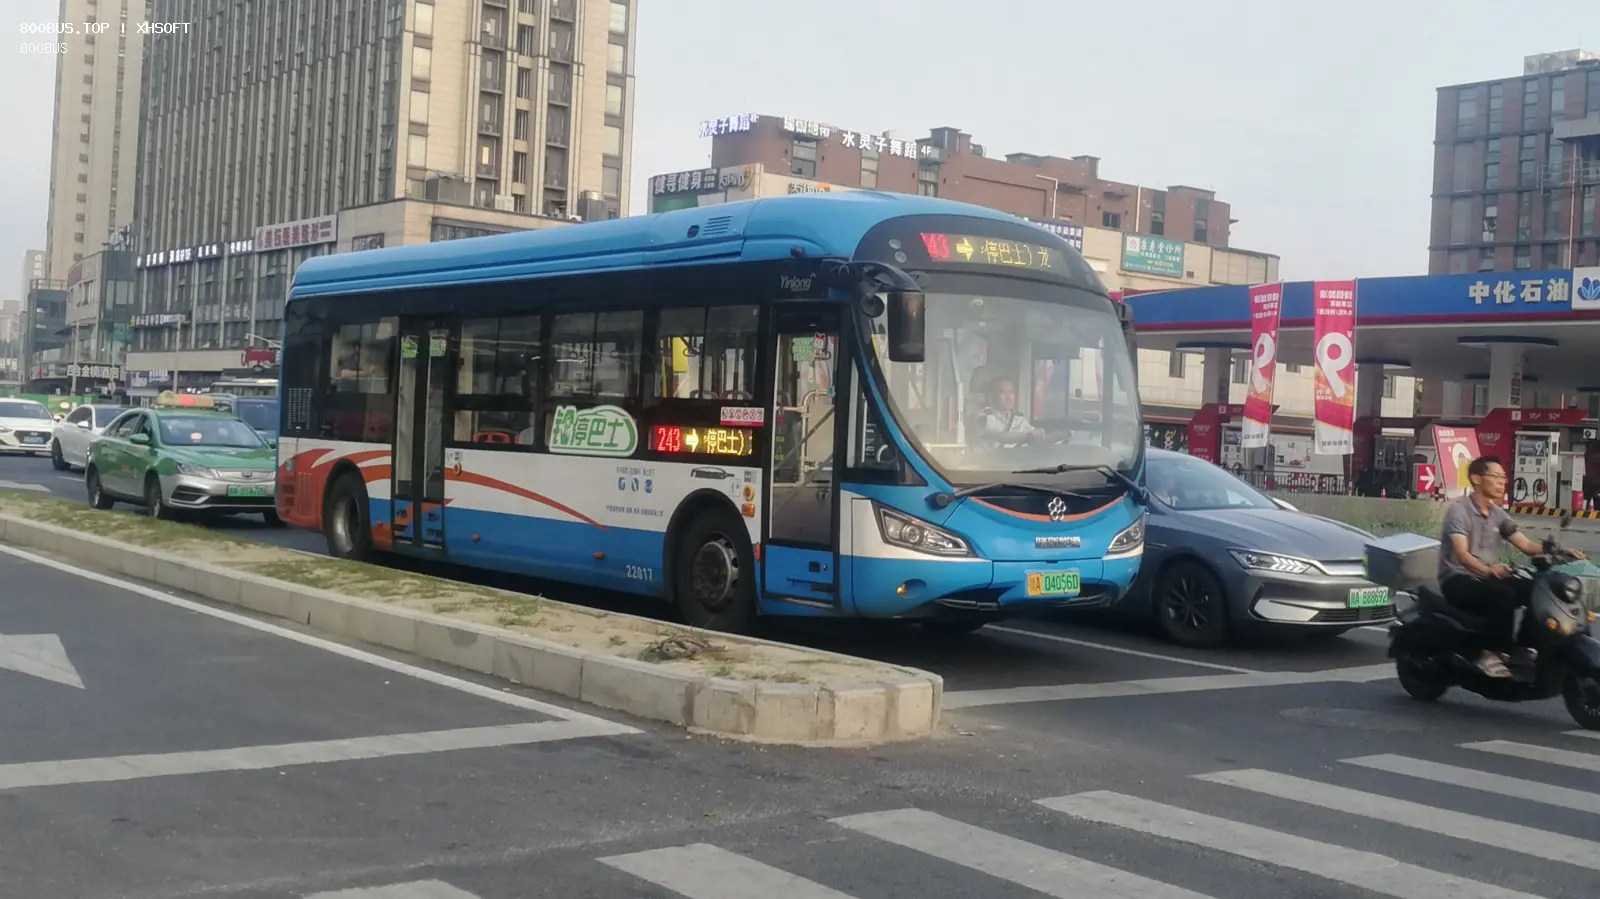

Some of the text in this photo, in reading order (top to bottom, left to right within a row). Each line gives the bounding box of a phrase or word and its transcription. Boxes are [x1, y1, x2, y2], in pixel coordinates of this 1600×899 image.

[699, 114, 750, 138] 水灵子舞蹈
[842, 131, 932, 160] 水灵子舞蹈 4F
[780, 273, 813, 291] Yinlong
[1468, 278, 1569, 305] 中化石油
[658, 427, 680, 452] 243
[626, 565, 653, 581] 22017
[1044, 574, 1079, 592] 04056D
